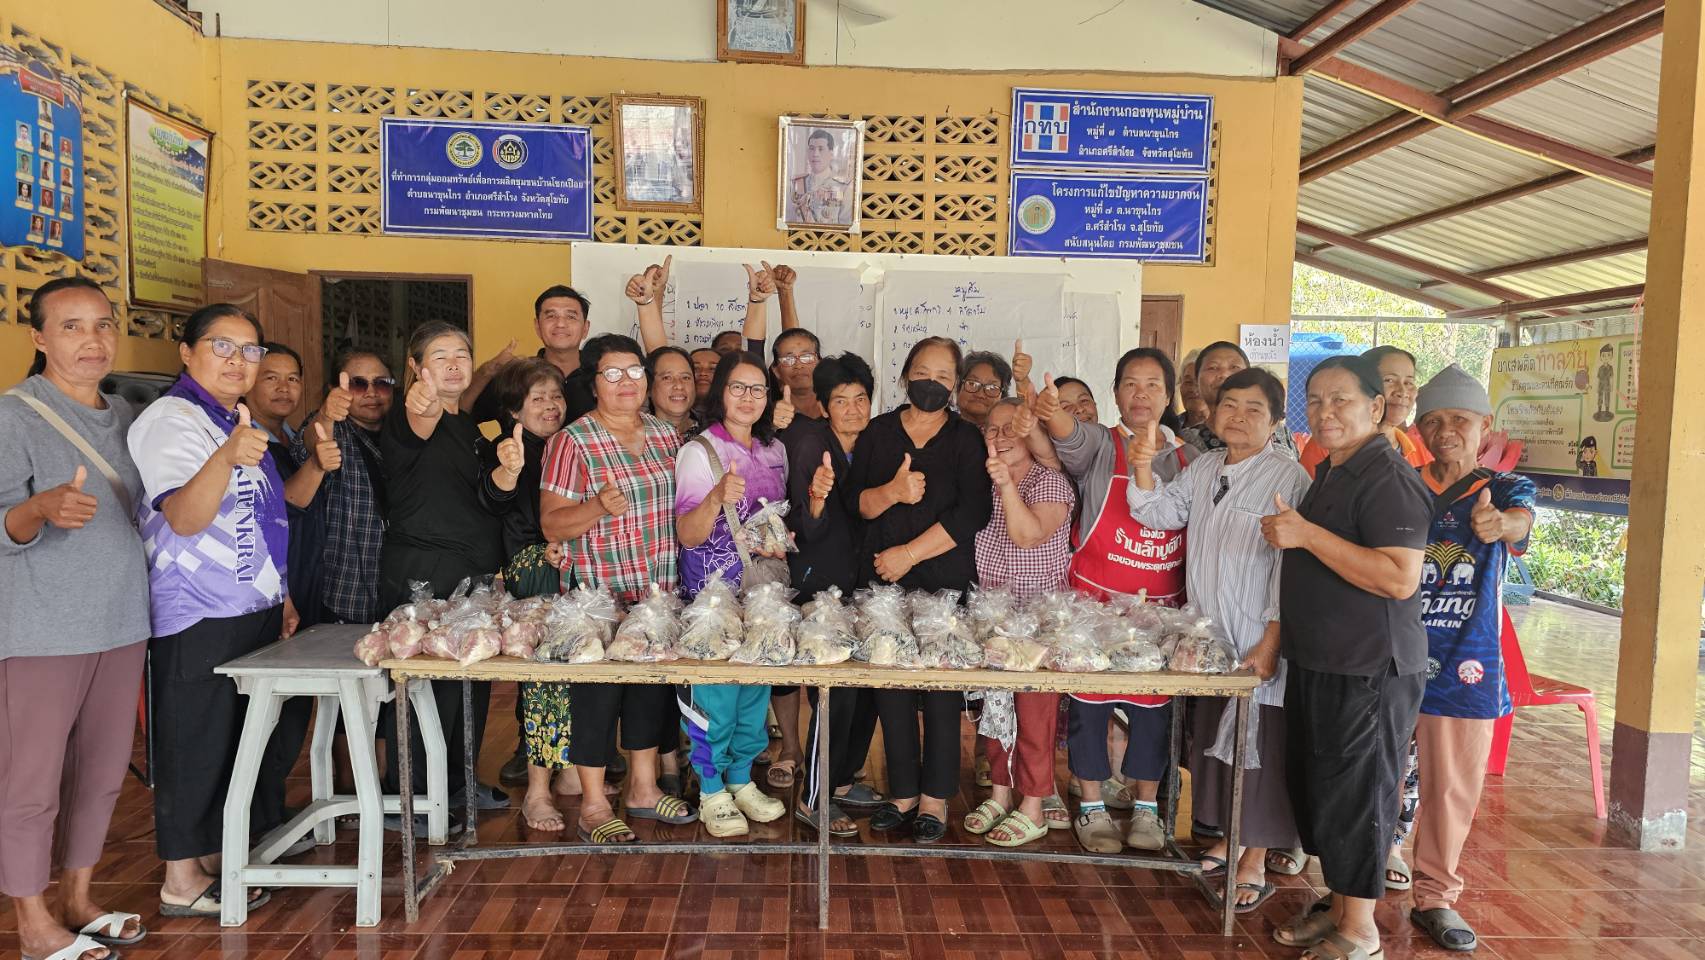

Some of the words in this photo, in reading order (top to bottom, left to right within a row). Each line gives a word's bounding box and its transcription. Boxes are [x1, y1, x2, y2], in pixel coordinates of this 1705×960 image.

[1072, 100, 1203, 125] สำนักงานกองทุนหมู่บ้าน
[1024, 119, 1068, 135] กทบ
[1086, 124, 1105, 139] หมู่ที่
[1122, 126, 1179, 142] ตำบลนาขุนไกร
[1078, 144, 1135, 157] อำเภอศรีสำโรง
[1142, 146, 1193, 162] จังหวัดสุโขทัย
[407, 188, 461, 203] ตำบลนาขุนไกร
[465, 190, 518, 202] อำเภอศรีสำโรง
[521, 192, 569, 207] จังหวัดสุโขทัย
[1052, 182, 1200, 201] โครงการแก้ไขปัญหาความยากจน
[424, 205, 483, 219] กรมพัฒนาชุมชน
[487, 208, 553, 220] กระทรวงมหาดไทย
[1084, 201, 1103, 219] หมู่ที่
[1116, 203, 1162, 219] ต.นาขุนไกร
[1085, 219, 1126, 231] อ.ศรีสำโรง
[1130, 222, 1164, 236] จ.สุโขทัย
[1064, 235, 1115, 252] สนับสนุนโดย
[1118, 237, 1183, 253] กรมพัฒนาชุมชน
[1245, 327, 1284, 347] ห้องน้ำ
[1421, 591, 1476, 620] hang
[1422, 619, 1463, 628] AIKIN
